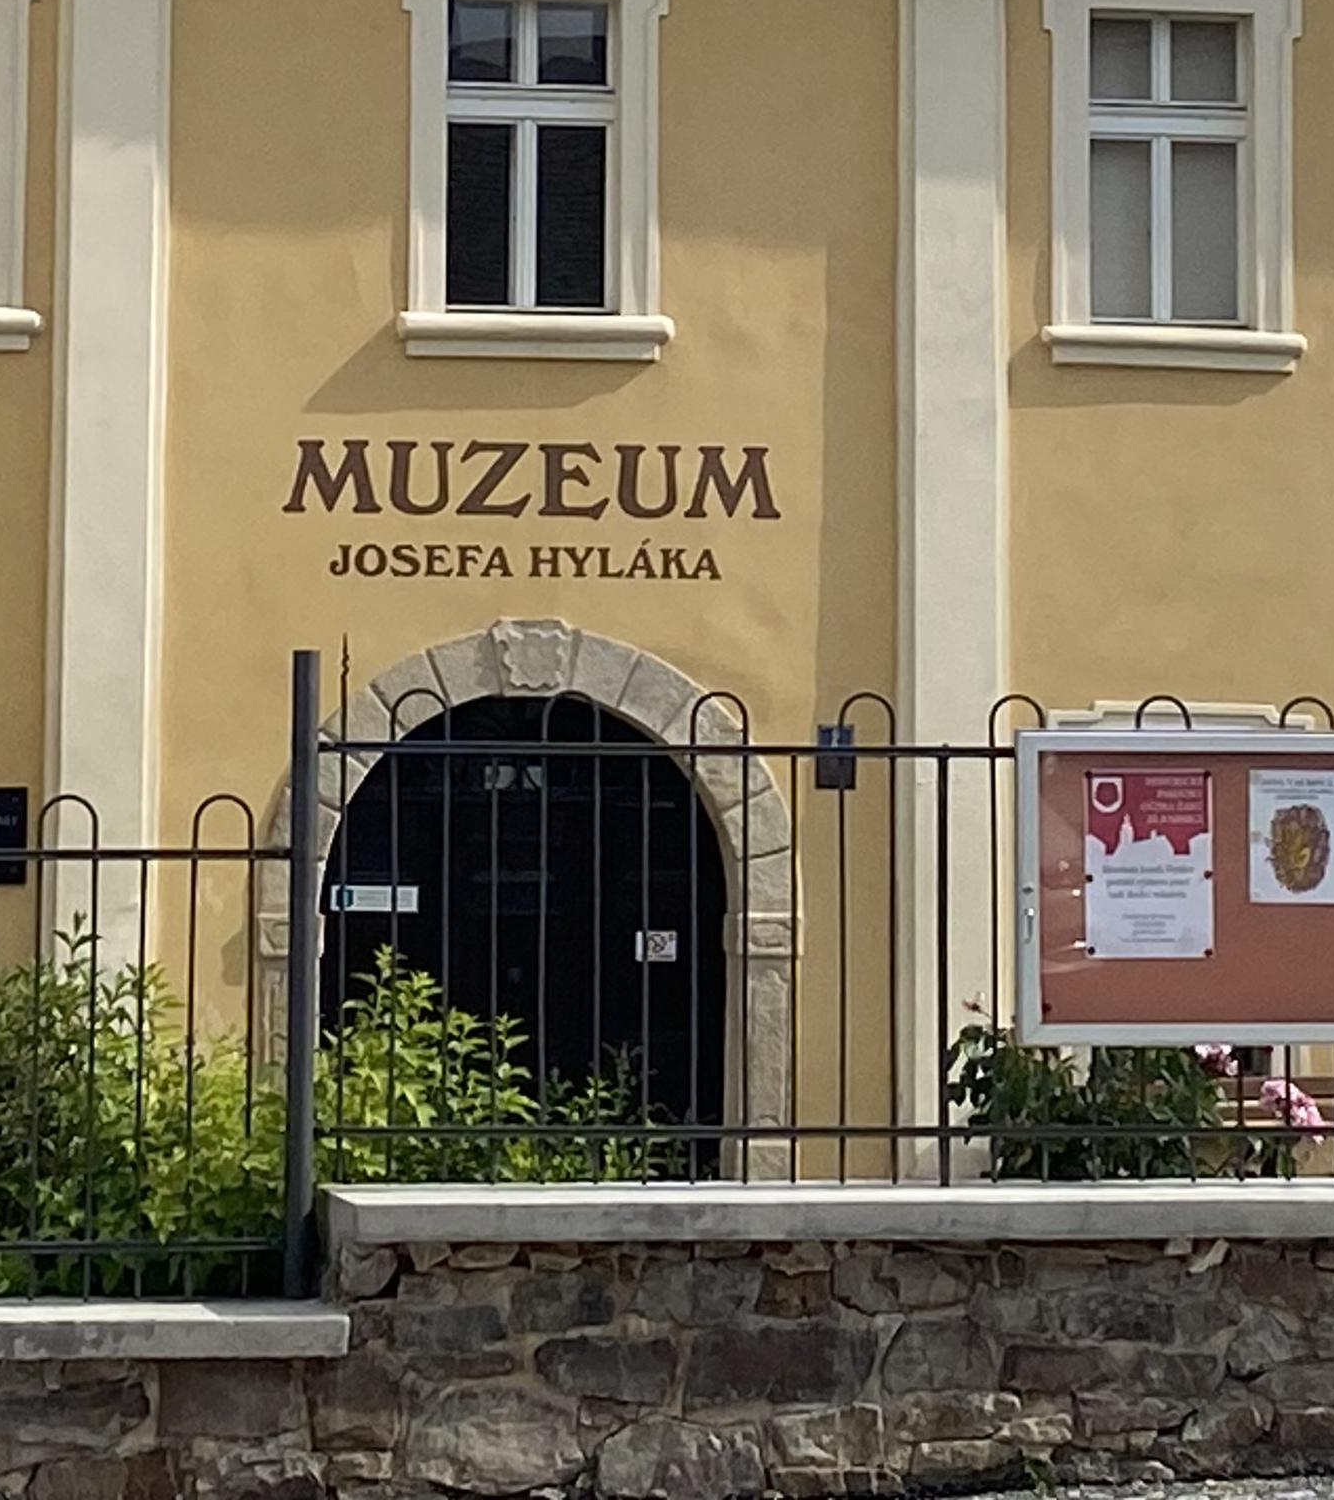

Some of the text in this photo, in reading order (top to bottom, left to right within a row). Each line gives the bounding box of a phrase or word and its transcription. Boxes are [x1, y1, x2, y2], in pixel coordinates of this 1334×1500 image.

[281, 439, 782, 521] MUZEUM
[328, 537, 723, 582] JOSEFA HYLÁKA
